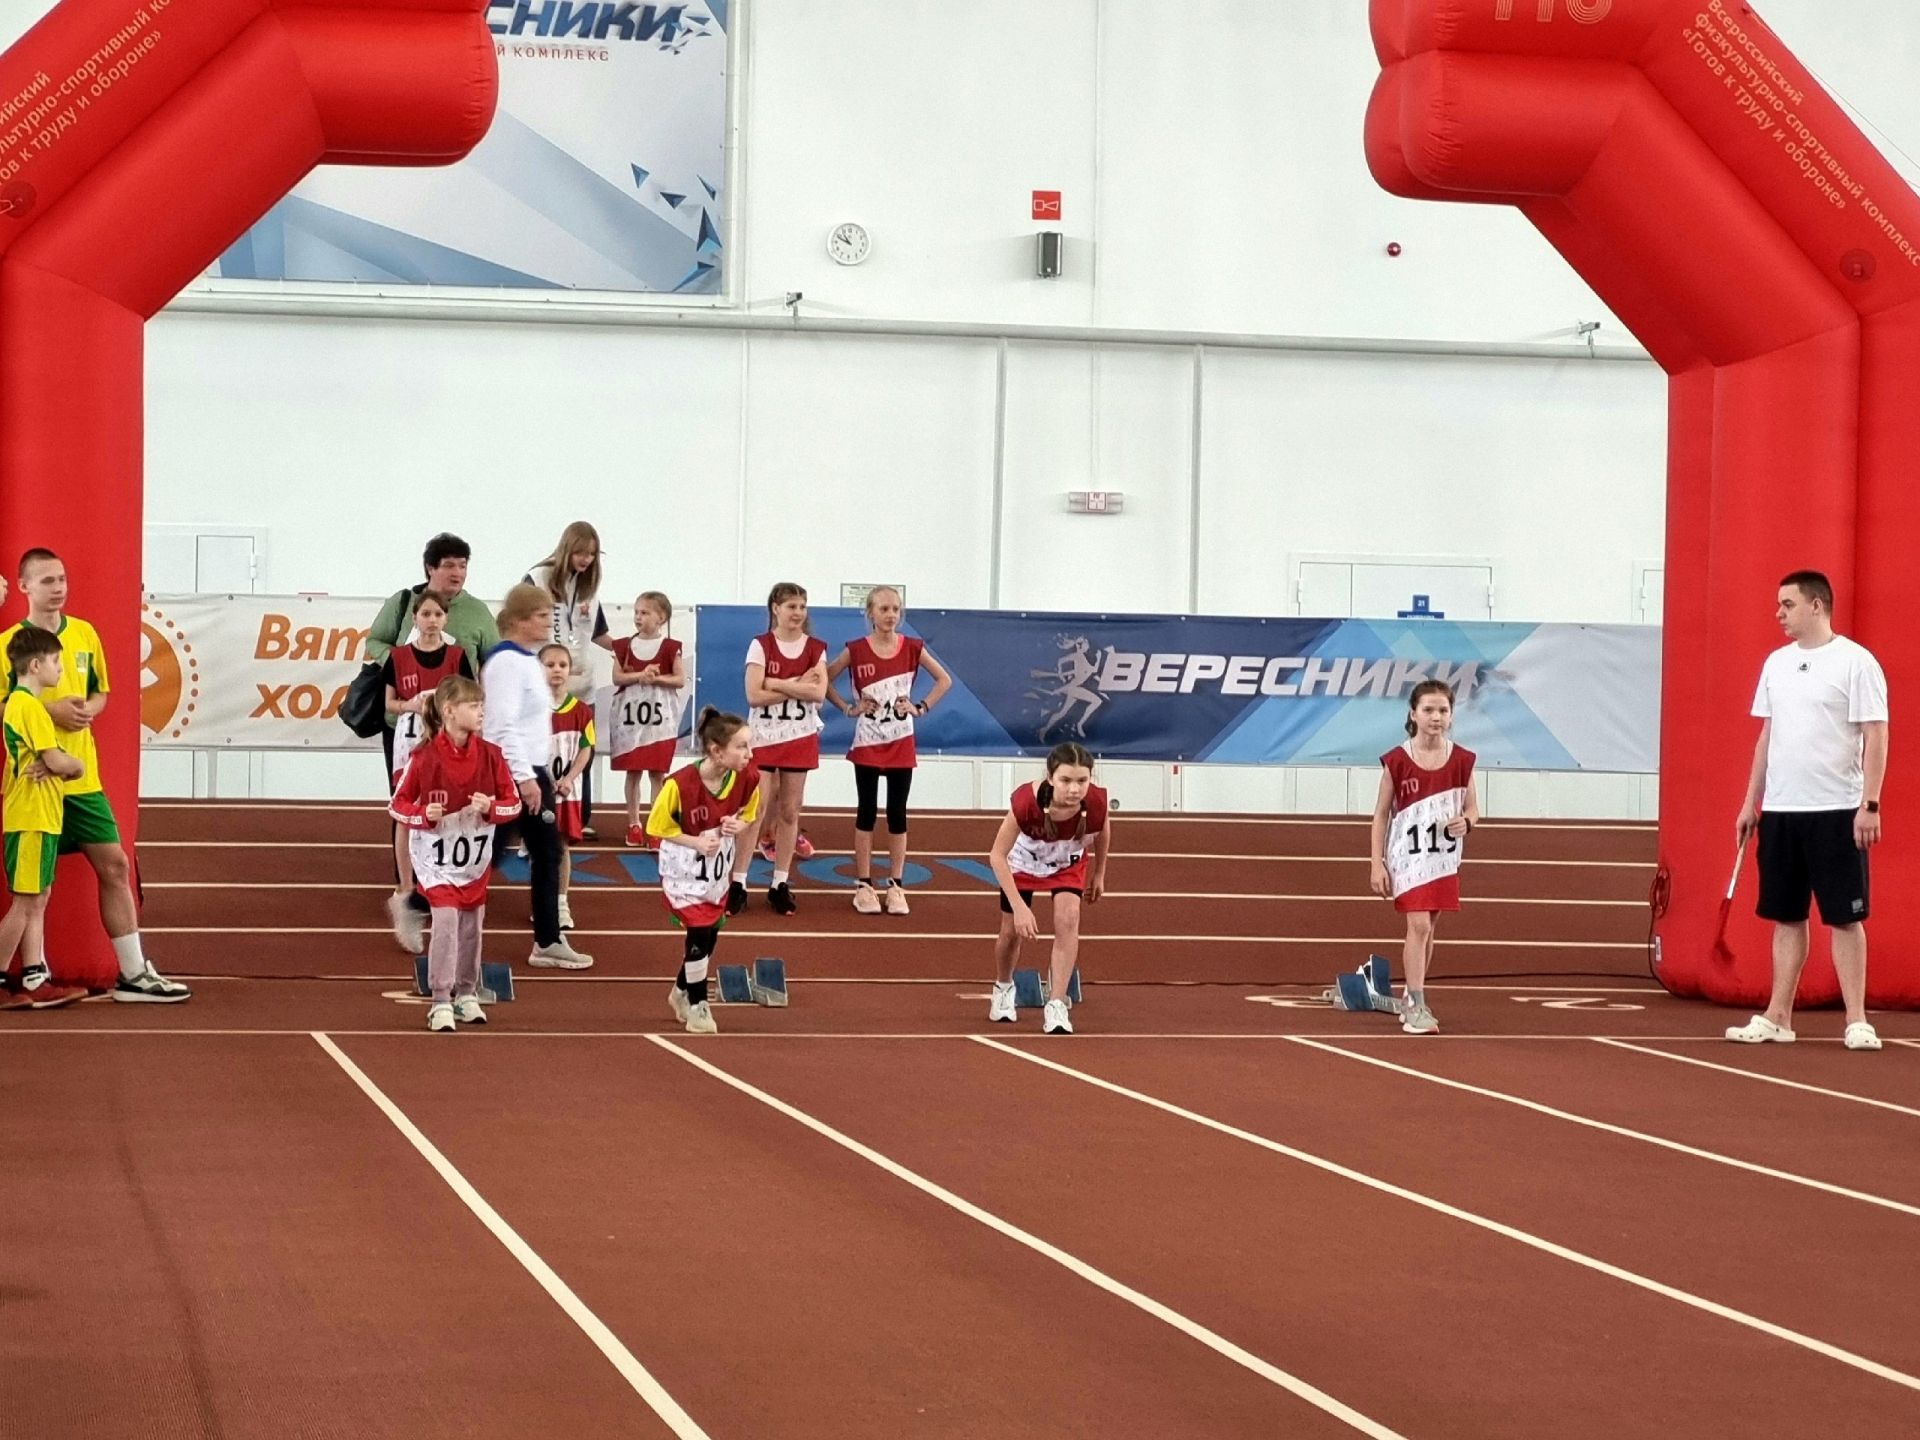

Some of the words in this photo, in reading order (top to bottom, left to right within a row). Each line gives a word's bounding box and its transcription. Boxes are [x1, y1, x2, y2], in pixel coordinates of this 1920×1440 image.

[514, 46, 609, 61] КОМПЛЕКС
[1708, 0, 1804, 105] Всероссийский
[19, 147, 33, 162] к
[30, 106, 77, 149] труду
[77, 95, 91, 110] и
[90, 30, 161, 97] обороне»
[1682, 28, 1726, 77] «Готов
[1723, 74, 1735, 89] к
[1734, 86, 1774, 130] труду
[1772, 128, 1786, 142] и
[1784, 141, 1846, 209] обороне»
[1695, 12, 1864, 199] физкультурно-спортивный
[1861, 198, 1920, 266] комплекс
[857, 663, 876, 679] ГТО
[1100, 652, 1479, 700] ВЕРЕСНИКИ
[623, 701, 663, 726] 105
[432, 835, 488, 868] 107
[695, 846, 732, 883] 10
